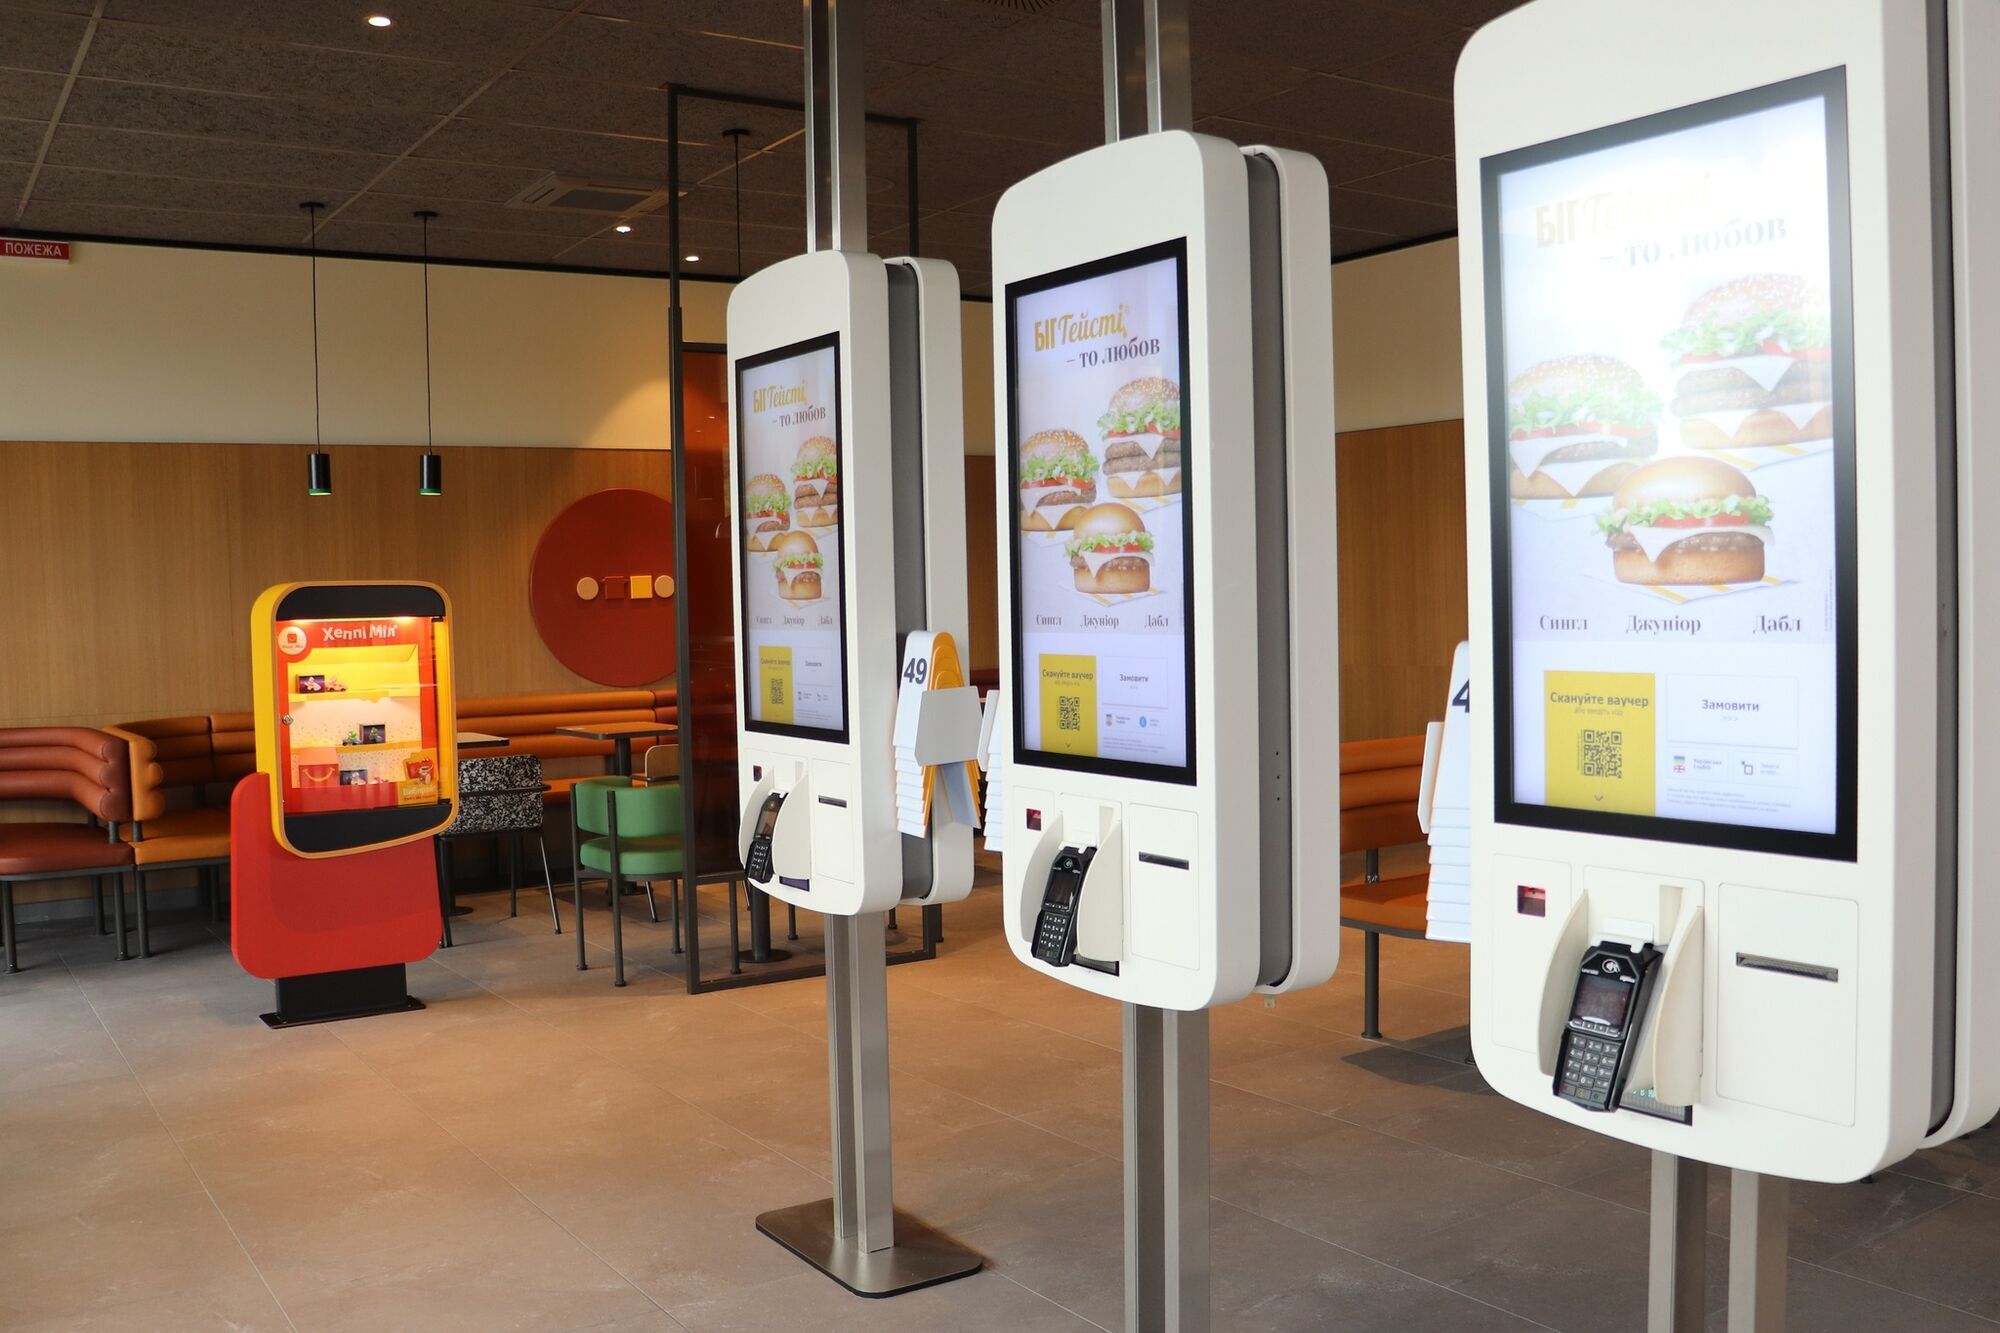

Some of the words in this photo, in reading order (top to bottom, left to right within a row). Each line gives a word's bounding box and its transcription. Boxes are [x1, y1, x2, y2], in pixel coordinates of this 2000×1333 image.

[5, 241, 62, 257] ПОЖЕЖА
[1624, 240, 1661, 267] то
[1668, 216, 1787, 261] любов
[1034, 319, 1056, 352] БІГ
[1079, 350, 1098, 368] то
[1102, 337, 1160, 364] любов
[780, 415, 791, 428] то
[792, 404, 826, 425] любов
[1080, 614, 1119, 630] Джуніор
[1144, 614, 1169, 629] Дабл
[1539, 614, 1588, 632] Сингл
[1625, 614, 1701, 635] Джуніор
[1752, 614, 1801, 635] Дабл
[322, 626, 367, 642] Хеппі
[904, 657, 927, 685] 49
[1119, 673, 1149, 683] Замовити
[1550, 691, 1604, 706] Скануйте
[1607, 696, 1649, 709] ваучер
[1701, 698, 1760, 712] Замовити
